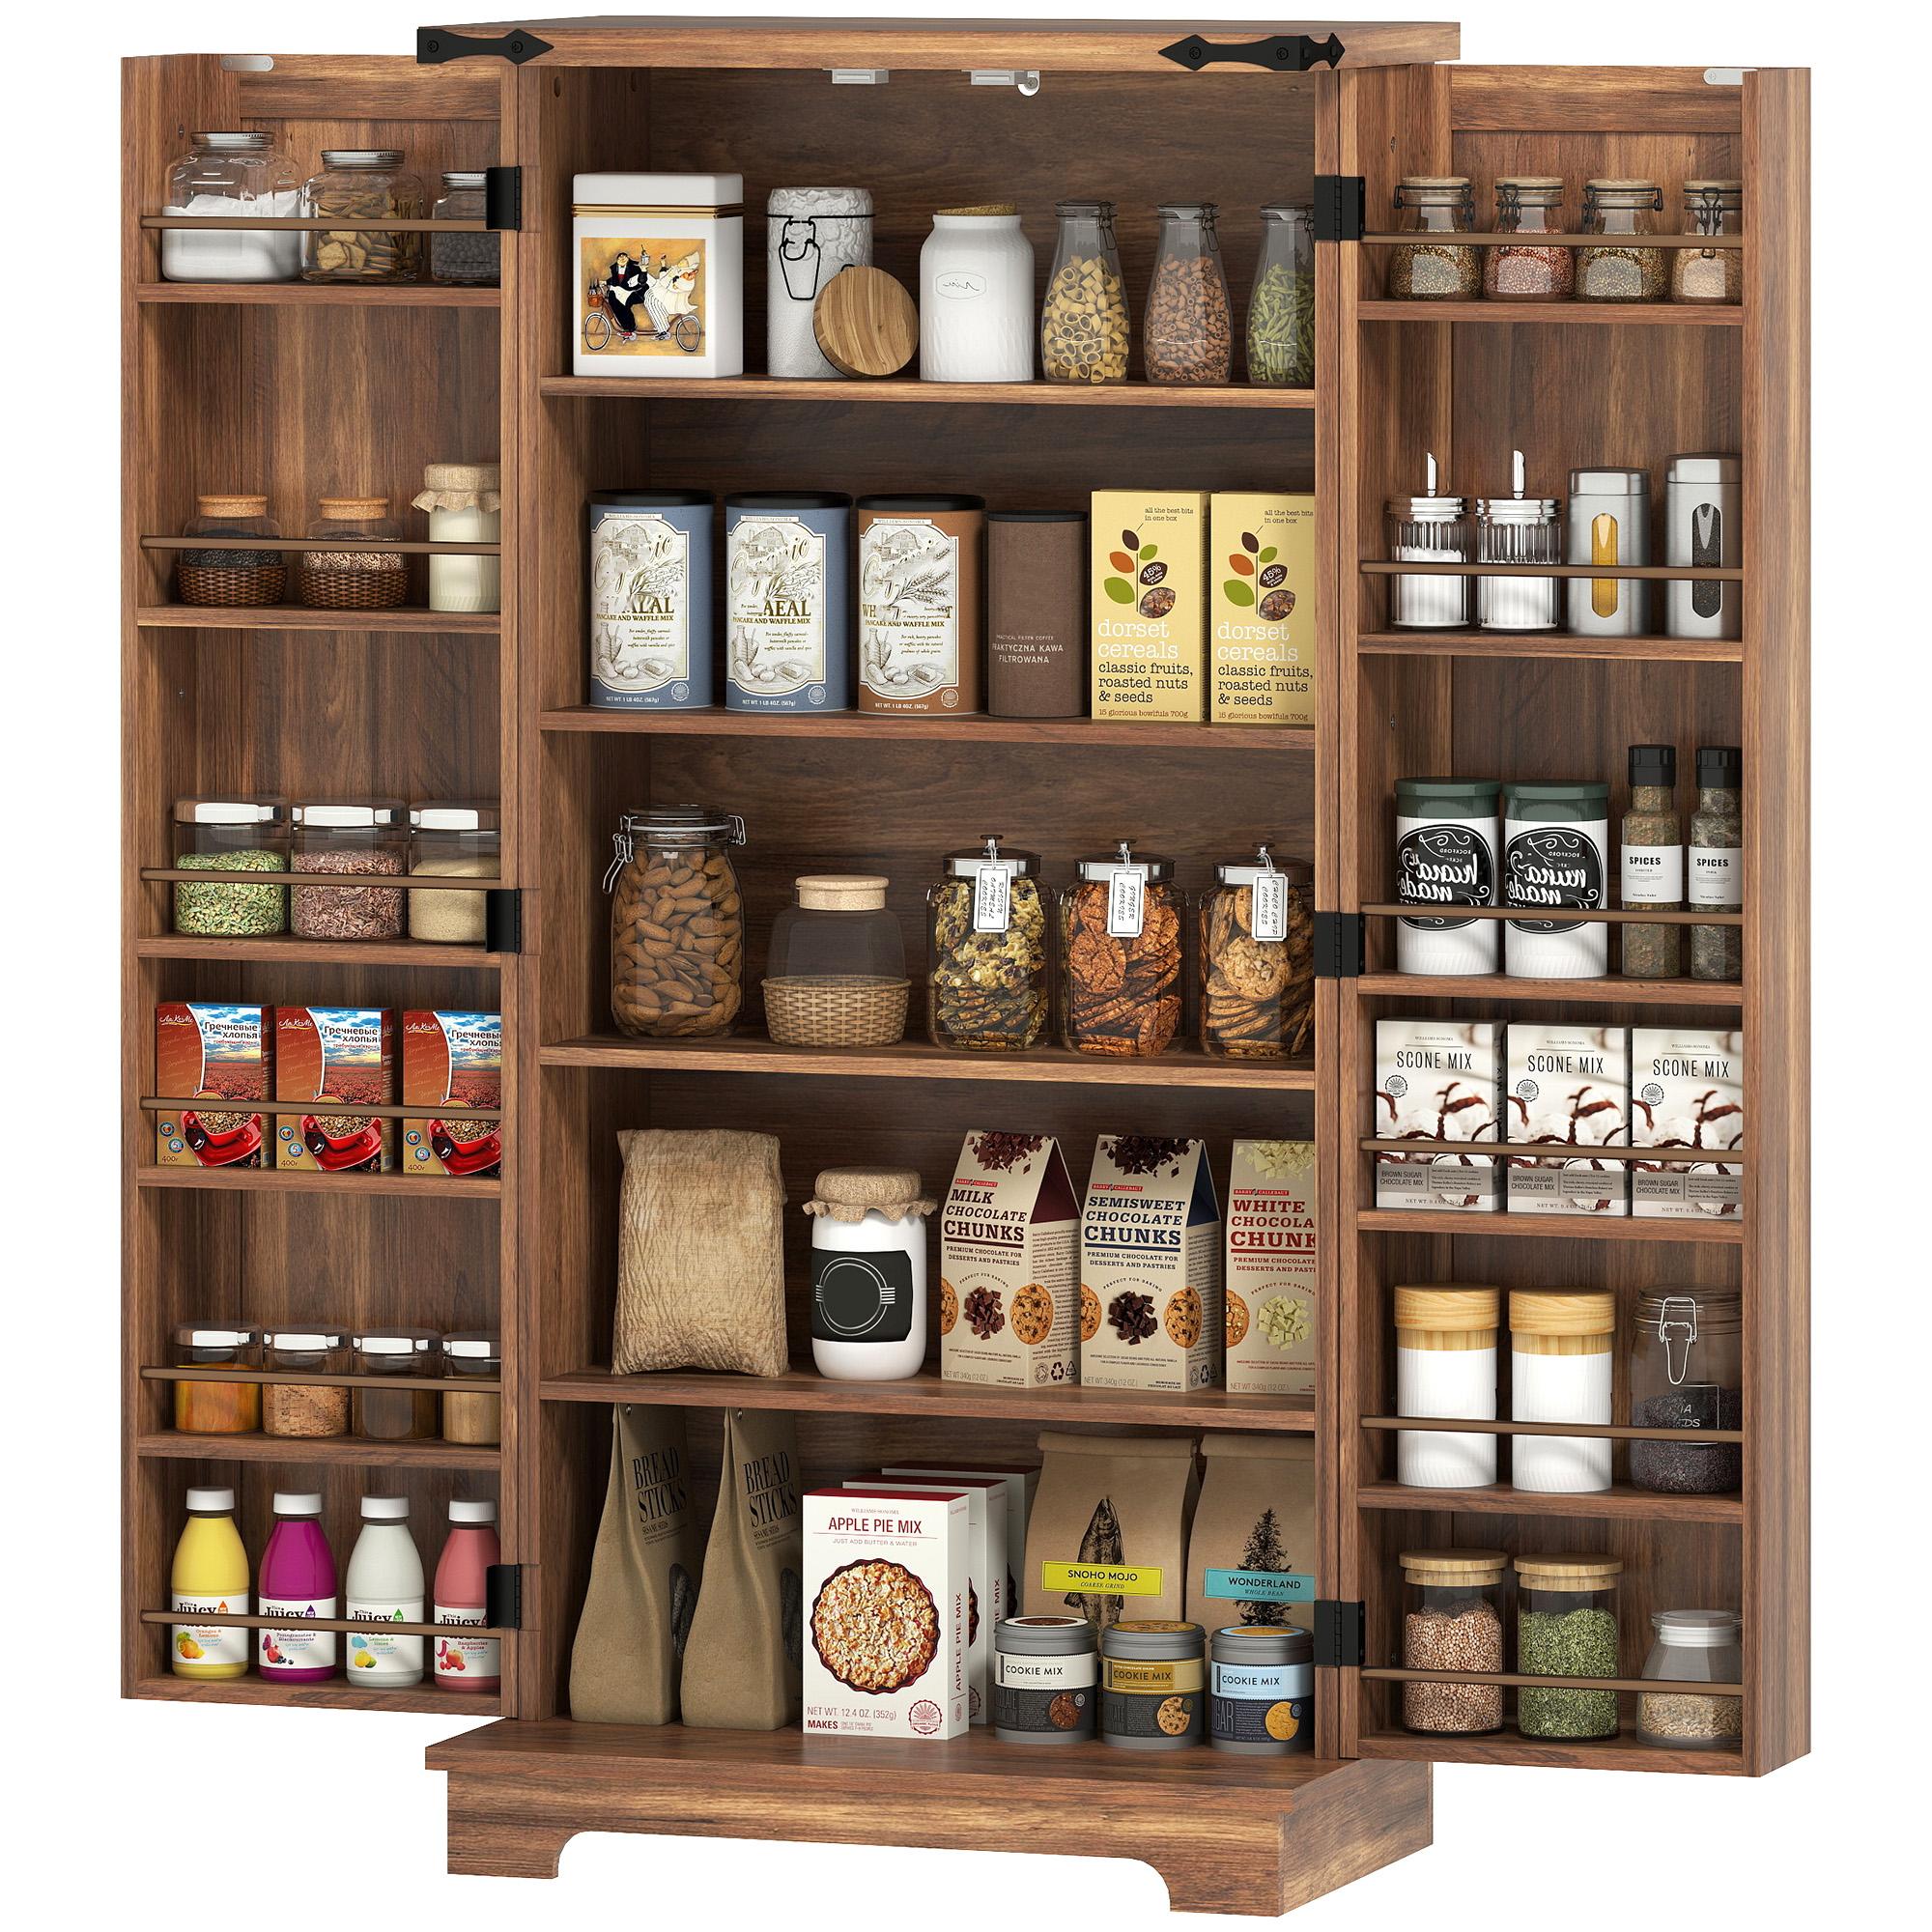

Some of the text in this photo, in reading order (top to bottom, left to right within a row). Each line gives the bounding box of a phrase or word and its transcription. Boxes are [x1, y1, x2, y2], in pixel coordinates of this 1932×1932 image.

[1097, 618, 1170, 638] dorset
[1217, 621, 1290, 640] dorset
[1097, 641, 1179, 659] cereals
[1217, 644, 1298, 662] cereals
[999, 655, 1049, 664] FILTROWANA
[1098, 662, 1193, 676] classic fruits,
[1218, 665, 1314, 679] classic fruits,
[1098, 677, 1188, 690] roasted nuts
[1218, 680, 1308, 693] roasted nuts
[1098, 690, 1153, 703] & seeds
[1218, 693, 1273, 706] & seeds
[1109, 709, 1137, 718] glorious
[1290, 713, 1309, 722] 700g
[1629, 856, 1662, 866] SPICES
[1696, 858, 1729, 867] SPICES
[204, 1022, 258, 1032] Гречневые
[325, 1026, 378, 1036] Гречневые
[1397, 1051, 1472, 1069] SCONE MIX
[1527, 1055, 1604, 1074] SCONE MIX
[1653, 1059, 1729, 1078] SCONE MIX
[951, 1189, 995, 1204] MILK
[1089, 1197, 1185, 1211] SEMISWEET
[1233, 1200, 1305, 1213] WHITE
[946, 1205, 1027, 1222] CHOCOLATE
[1086, 1211, 1182, 1226] CHOCOLATE
[1232, 1216, 1314, 1229] CHOCOLA
[944, 1219, 1024, 1241] CHUNKS
[1084, 1226, 1180, 1245] CHUNKS
[1231, 1232, 1316, 1248] CHUNK
[949, 1254, 978, 1263] DESSERTS
[975, 1248, 1009, 1257] CHOCOLATE
[633, 1447, 680, 1490] BREAD
[743, 1452, 790, 1494] BREAD
[638, 1478, 688, 1522] STICKS
[749, 1483, 797, 1528] STICKS
[828, 1517, 922, 1534] APPLE PIE MIX
[1068, 1570, 1137, 1581] SNOHO MOJO
[1229, 1577, 1300, 1589] WONDERLAND
[1006, 1665, 1040, 1675] COOKIE
[1114, 1670, 1149, 1680] COOKIE
[1222, 1675, 1258, 1685] COOKIE
[808, 1707, 822, 1716] NET
[873, 1709, 897, 1720] (352g)
[808, 1719, 838, 1729] MAKES
